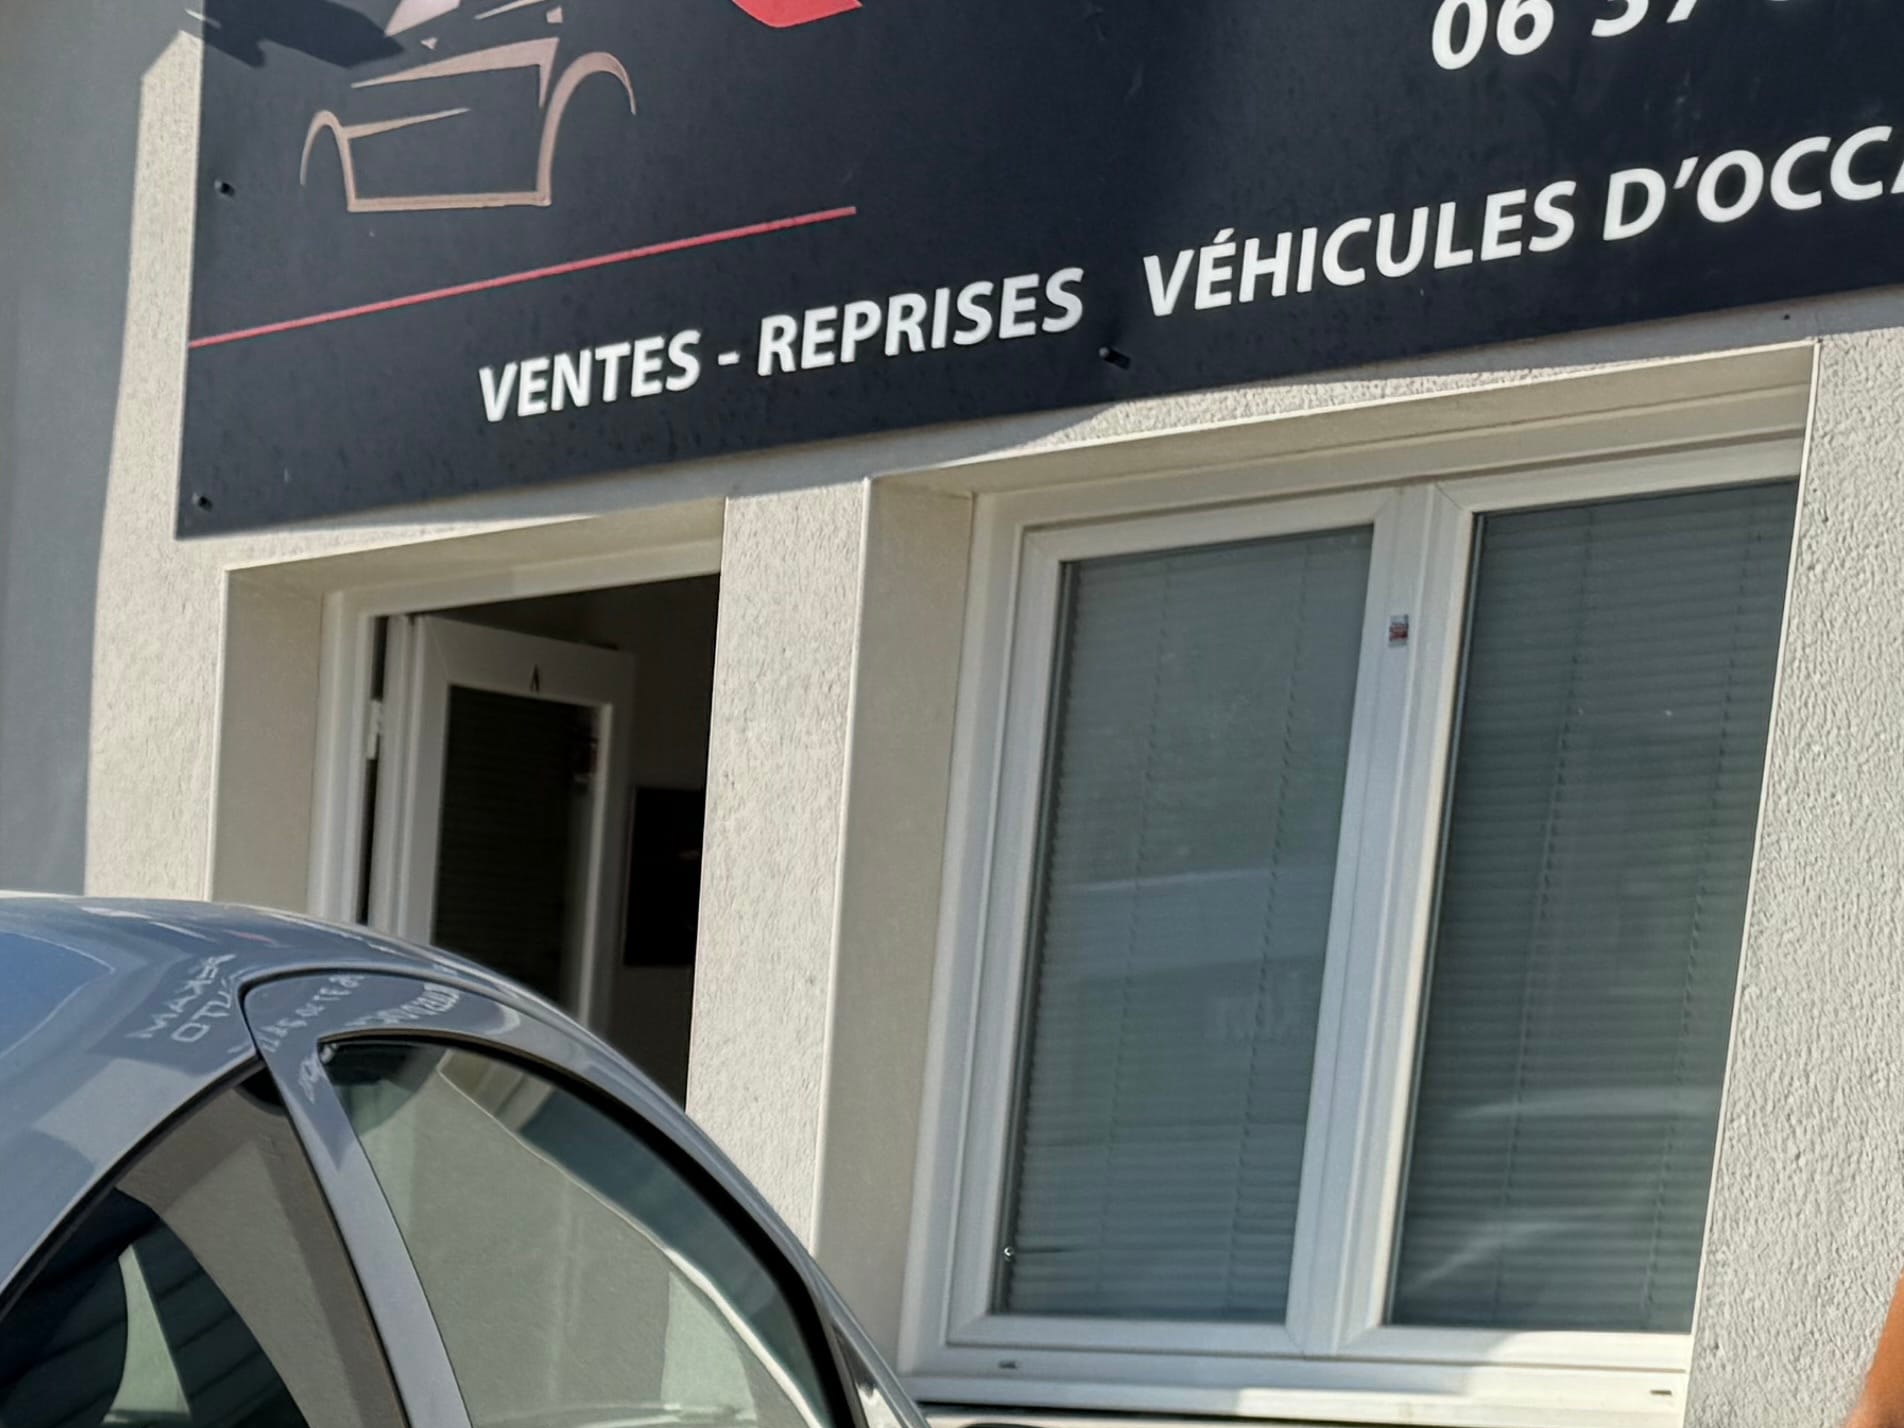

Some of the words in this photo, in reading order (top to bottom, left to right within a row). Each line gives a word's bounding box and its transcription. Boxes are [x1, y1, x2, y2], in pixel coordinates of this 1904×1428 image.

[478, 328, 702, 423] VENTES
[757, 266, 1085, 377] REPRISES
[1142, 180, 1577, 318] VÉHICULES
[1602, 125, 1904, 242] D'OCC
